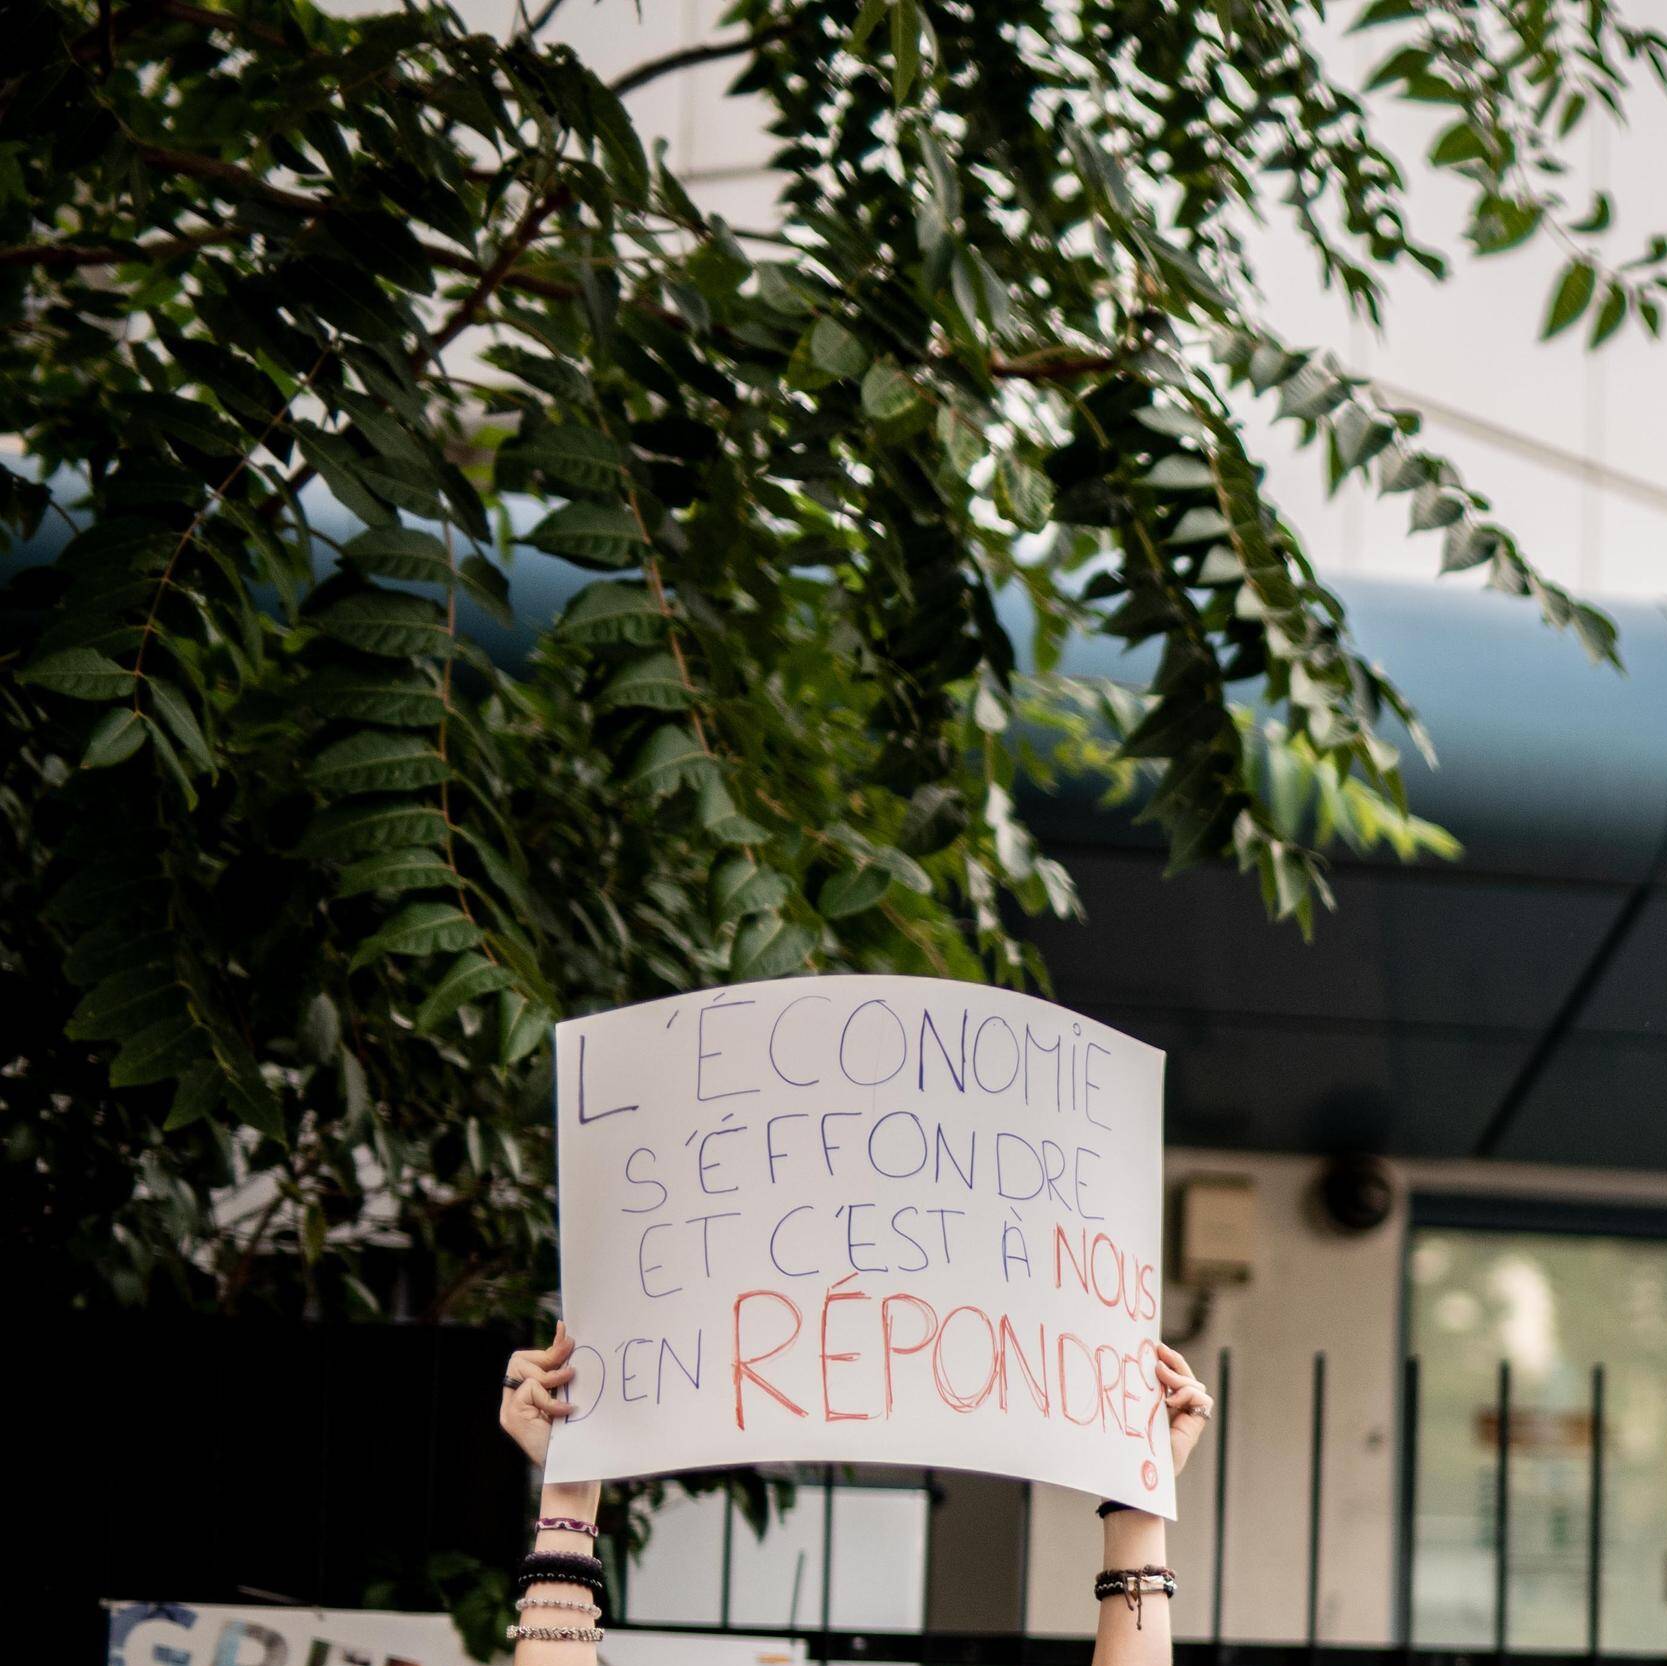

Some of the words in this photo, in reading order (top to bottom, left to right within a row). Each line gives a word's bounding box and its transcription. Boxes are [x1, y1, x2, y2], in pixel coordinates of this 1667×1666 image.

[620, 1110, 1105, 1221] S'ÉFFONDRE
[638, 1211, 742, 1299] ET
[769, 1202, 965, 1277] C'EST
[1001, 1205, 1031, 1283] À
[1053, 1222, 1156, 1322] NOUS
[563, 1328, 702, 1424] D'EN
